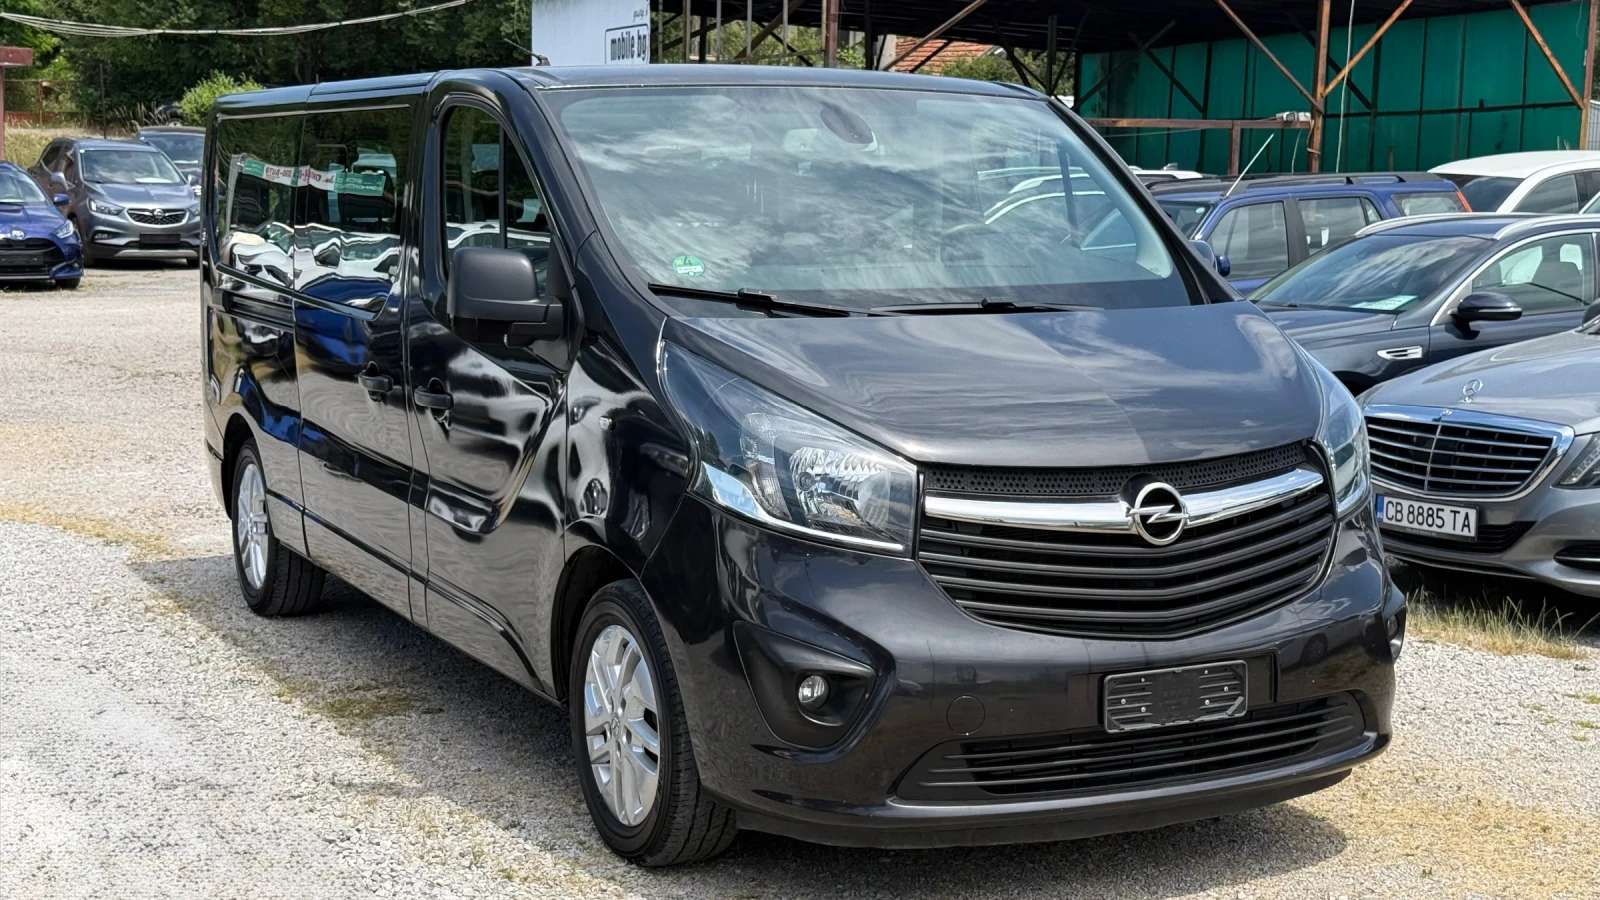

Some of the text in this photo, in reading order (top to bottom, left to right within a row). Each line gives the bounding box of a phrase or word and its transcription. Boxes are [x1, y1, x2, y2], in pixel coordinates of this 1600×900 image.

[1385, 500, 1472, 534] CB 8885 TA
